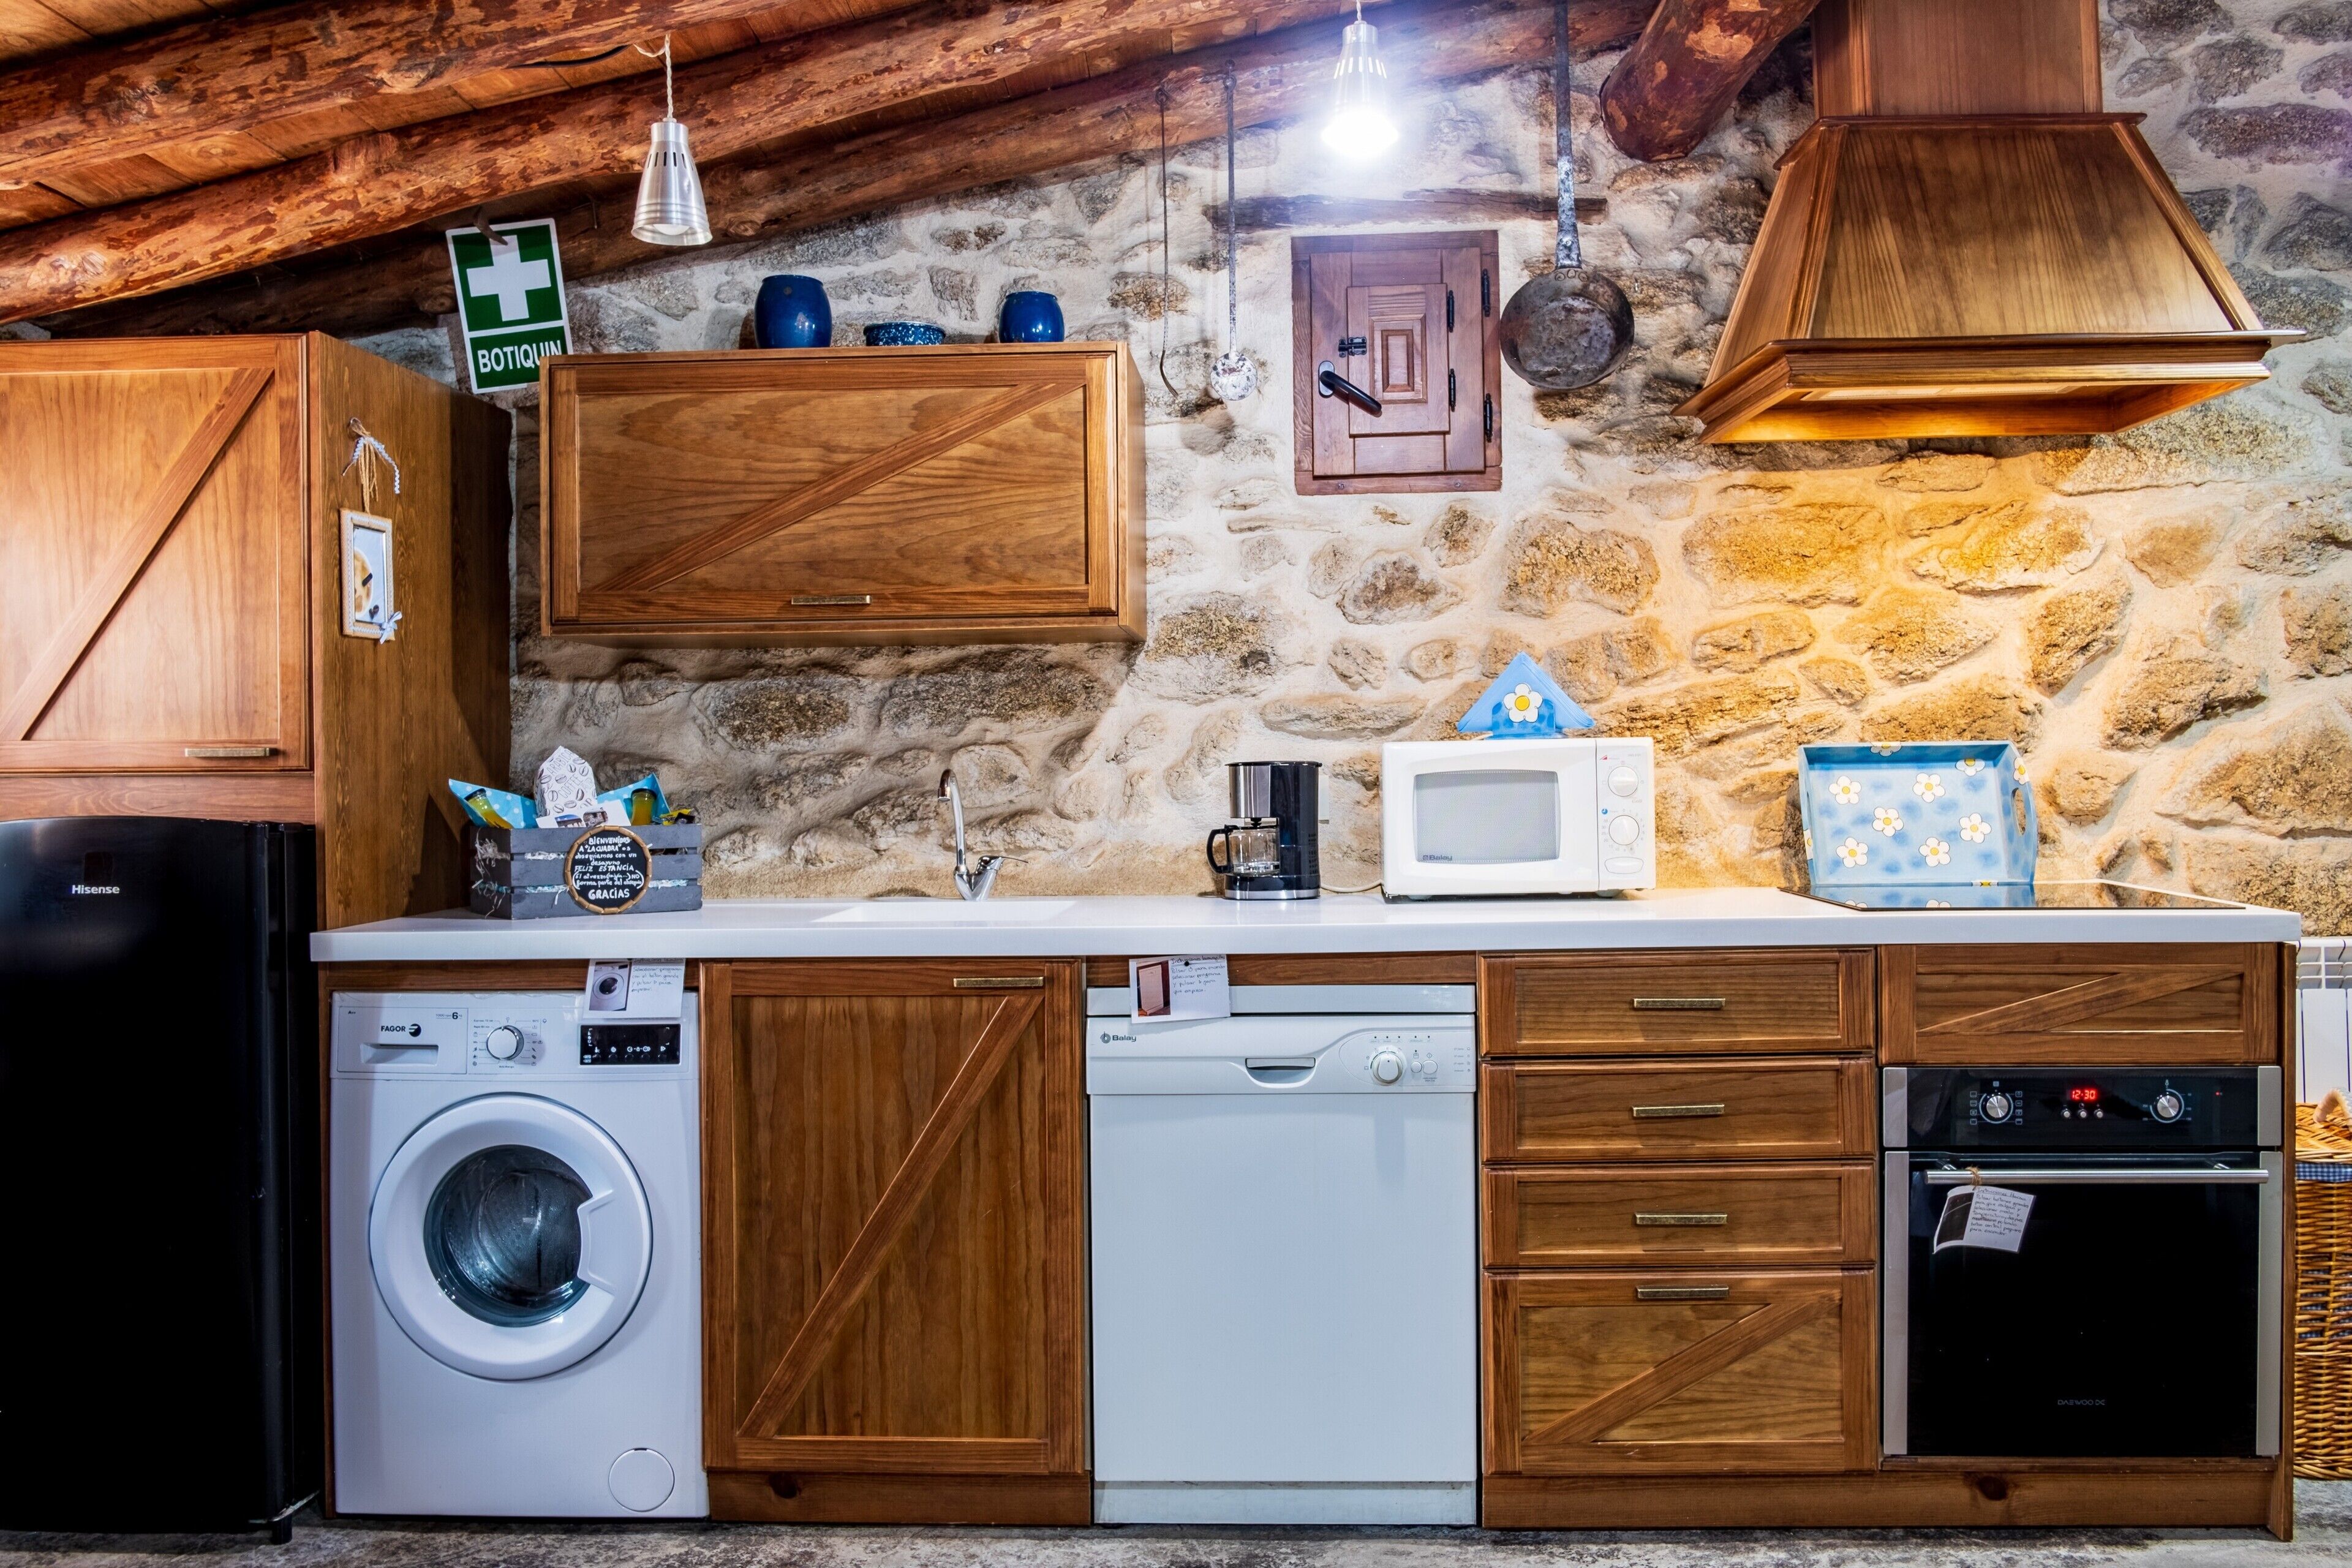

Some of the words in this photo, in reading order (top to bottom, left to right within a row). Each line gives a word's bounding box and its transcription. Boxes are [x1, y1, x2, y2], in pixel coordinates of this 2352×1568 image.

[477, 340, 562, 373] BOTIQUIN
[558, 774, 584, 798] COFFEE
[590, 858, 620, 867] desayuno
[72, 884, 120, 894] Hisense
[598, 879, 612, 888] parte
[588, 888, 630, 900] GRACIAS
